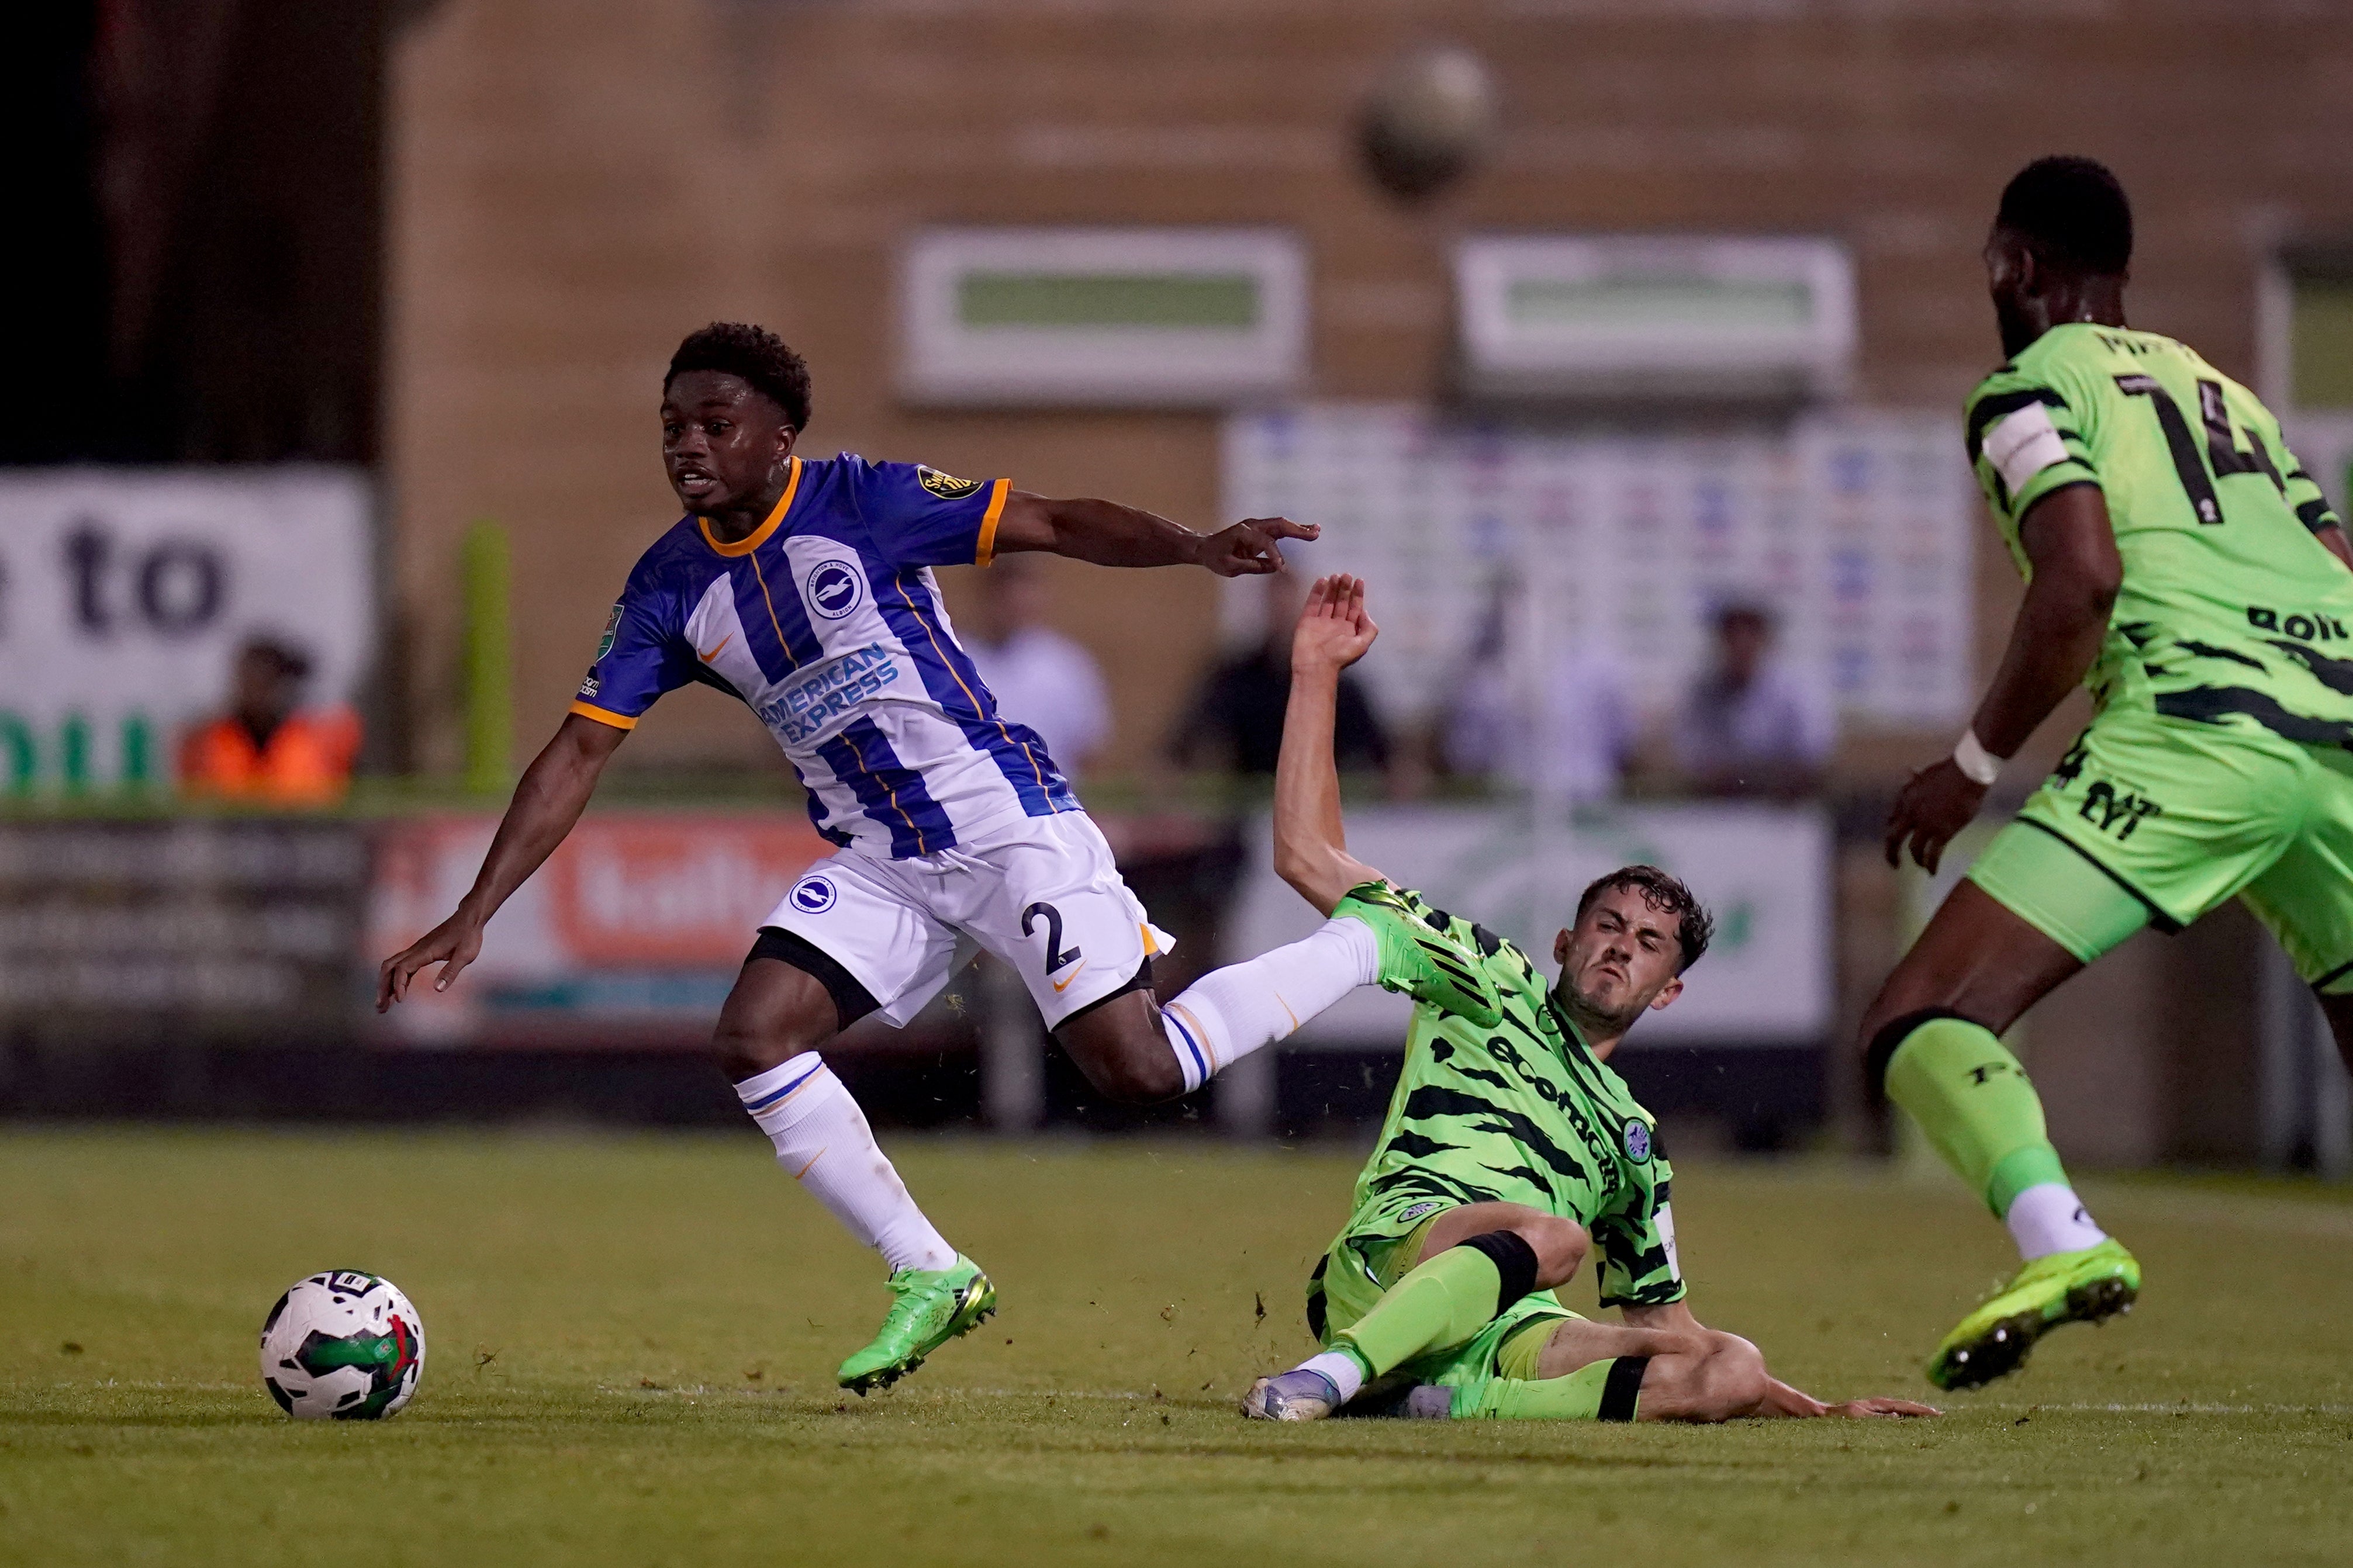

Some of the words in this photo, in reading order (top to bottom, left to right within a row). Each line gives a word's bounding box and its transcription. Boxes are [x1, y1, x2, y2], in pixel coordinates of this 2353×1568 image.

[2112, 374, 2286, 525] 14
[65, 522, 228, 639] to
[810, 565, 828, 587] BRIGHTON
[835, 563, 849, 571] HOVE
[832, 605, 852, 616] ALBION
[759, 641, 887, 725] AMERICAN
[780, 660, 899, 744] EXPRESS
[1021, 902, 1082, 976] 2
